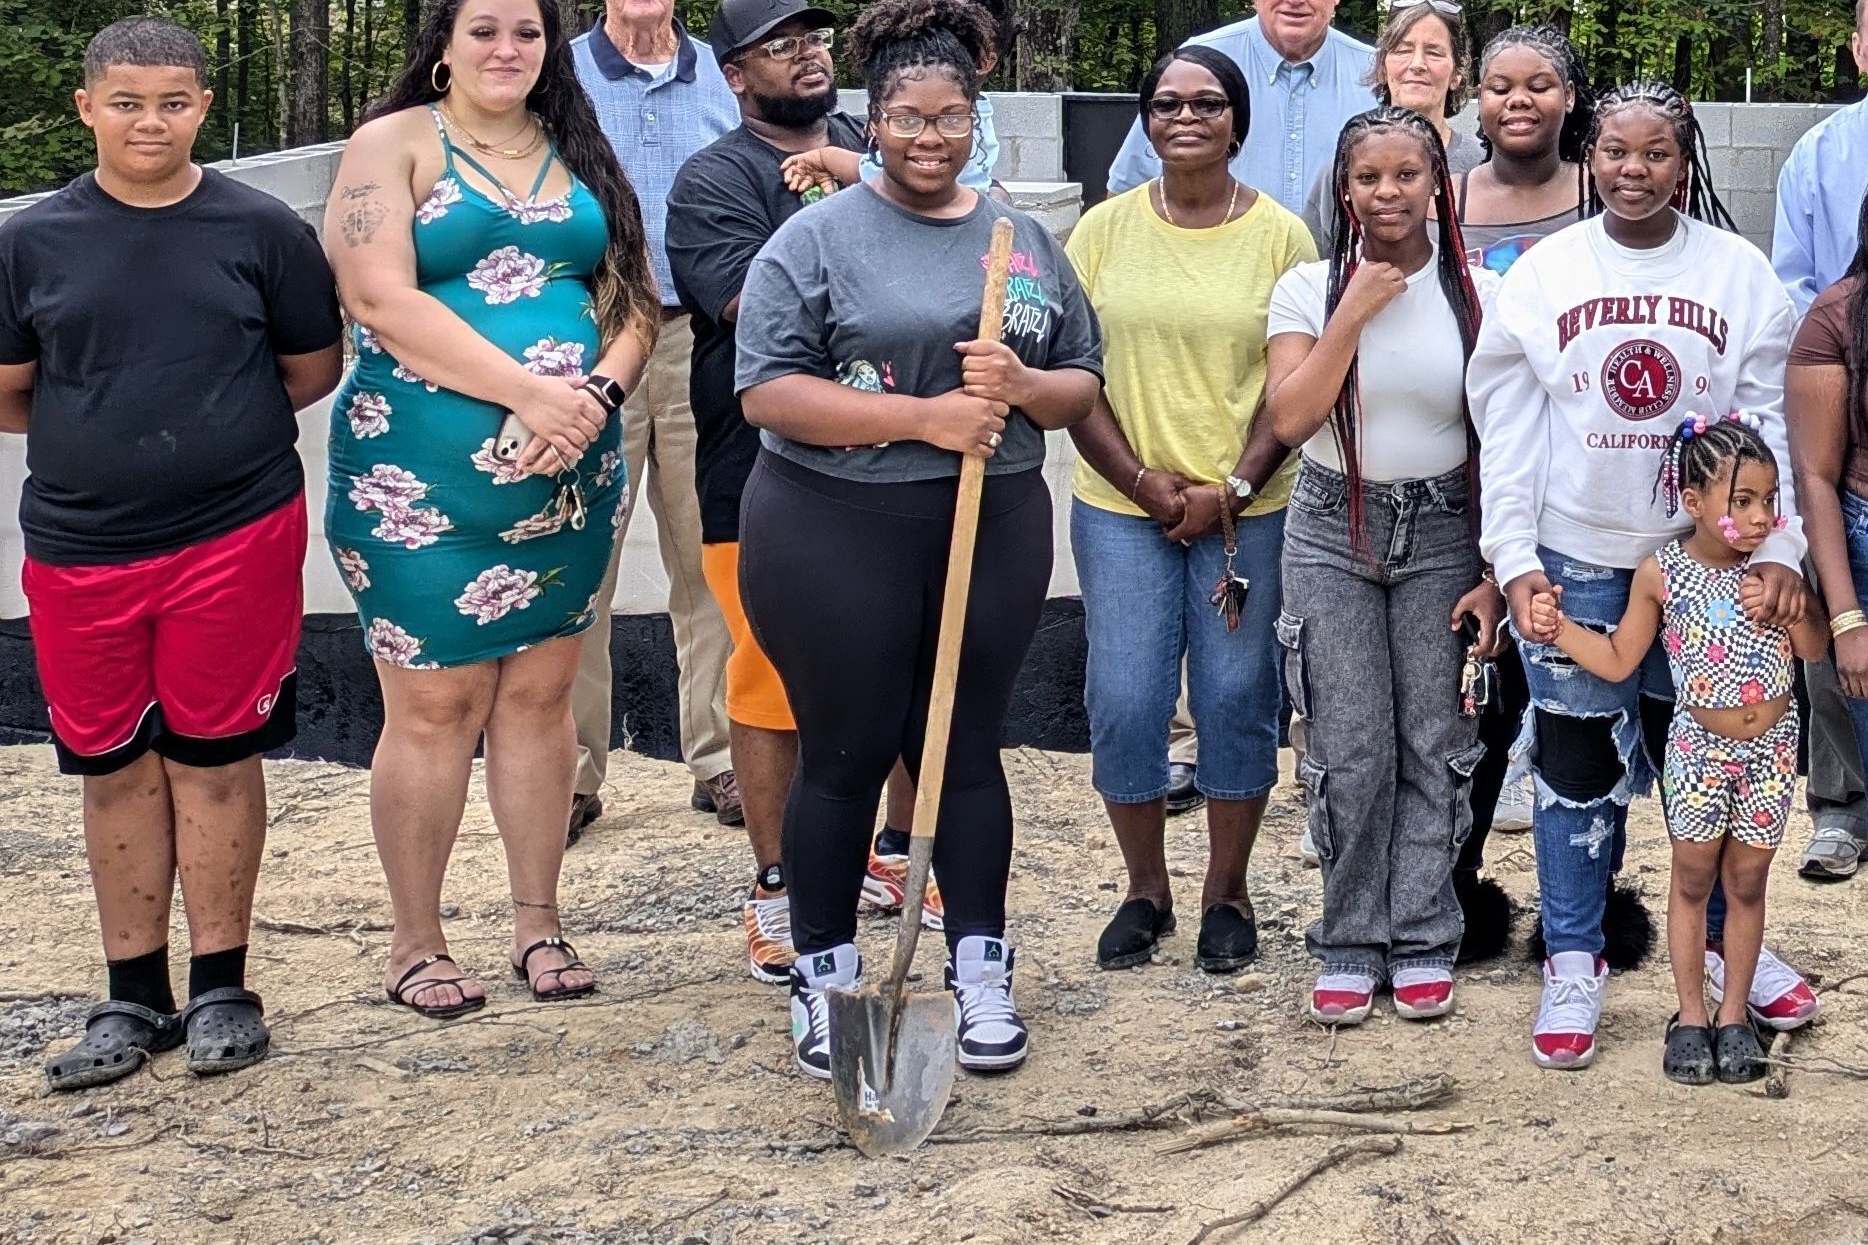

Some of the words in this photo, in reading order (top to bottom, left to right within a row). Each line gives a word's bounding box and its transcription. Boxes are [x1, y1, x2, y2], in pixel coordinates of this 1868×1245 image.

[1556, 295, 1663, 353] BEVERLY
[1667, 296, 1729, 356] HILLS
[1609, 345, 1643, 374] HEALTH
[1643, 346, 1652, 355] &
[1572, 370, 1590, 393] 19
[1620, 359, 1657, 399] CA
[1653, 348, 1676, 401] WELLNESS
[1606, 378, 1637, 415] MEMBER
[1638, 398, 1664, 415] CLUB
[1586, 432, 1674, 450] CALIFORN
